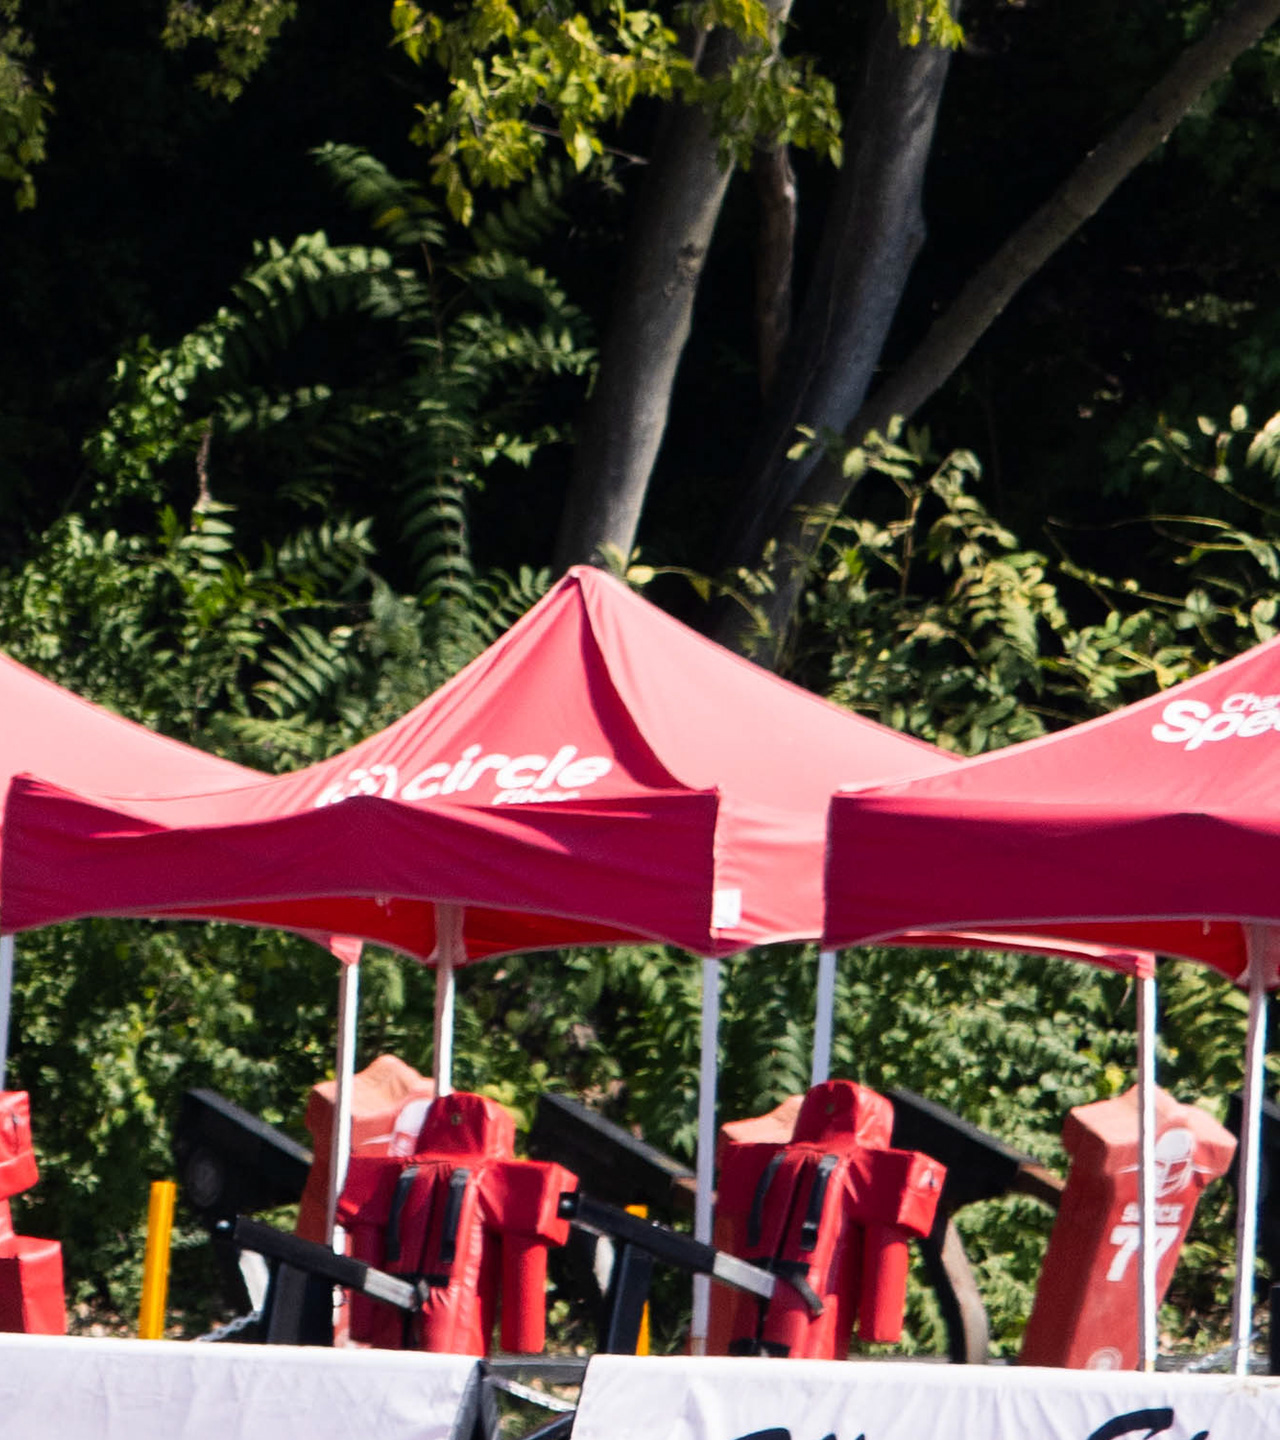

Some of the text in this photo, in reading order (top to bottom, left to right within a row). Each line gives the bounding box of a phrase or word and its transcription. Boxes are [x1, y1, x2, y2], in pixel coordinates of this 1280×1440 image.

[1151, 699, 1280, 751] Spe
[1222, 692, 1280, 713] Cha
[401, 744, 612, 801] circle
